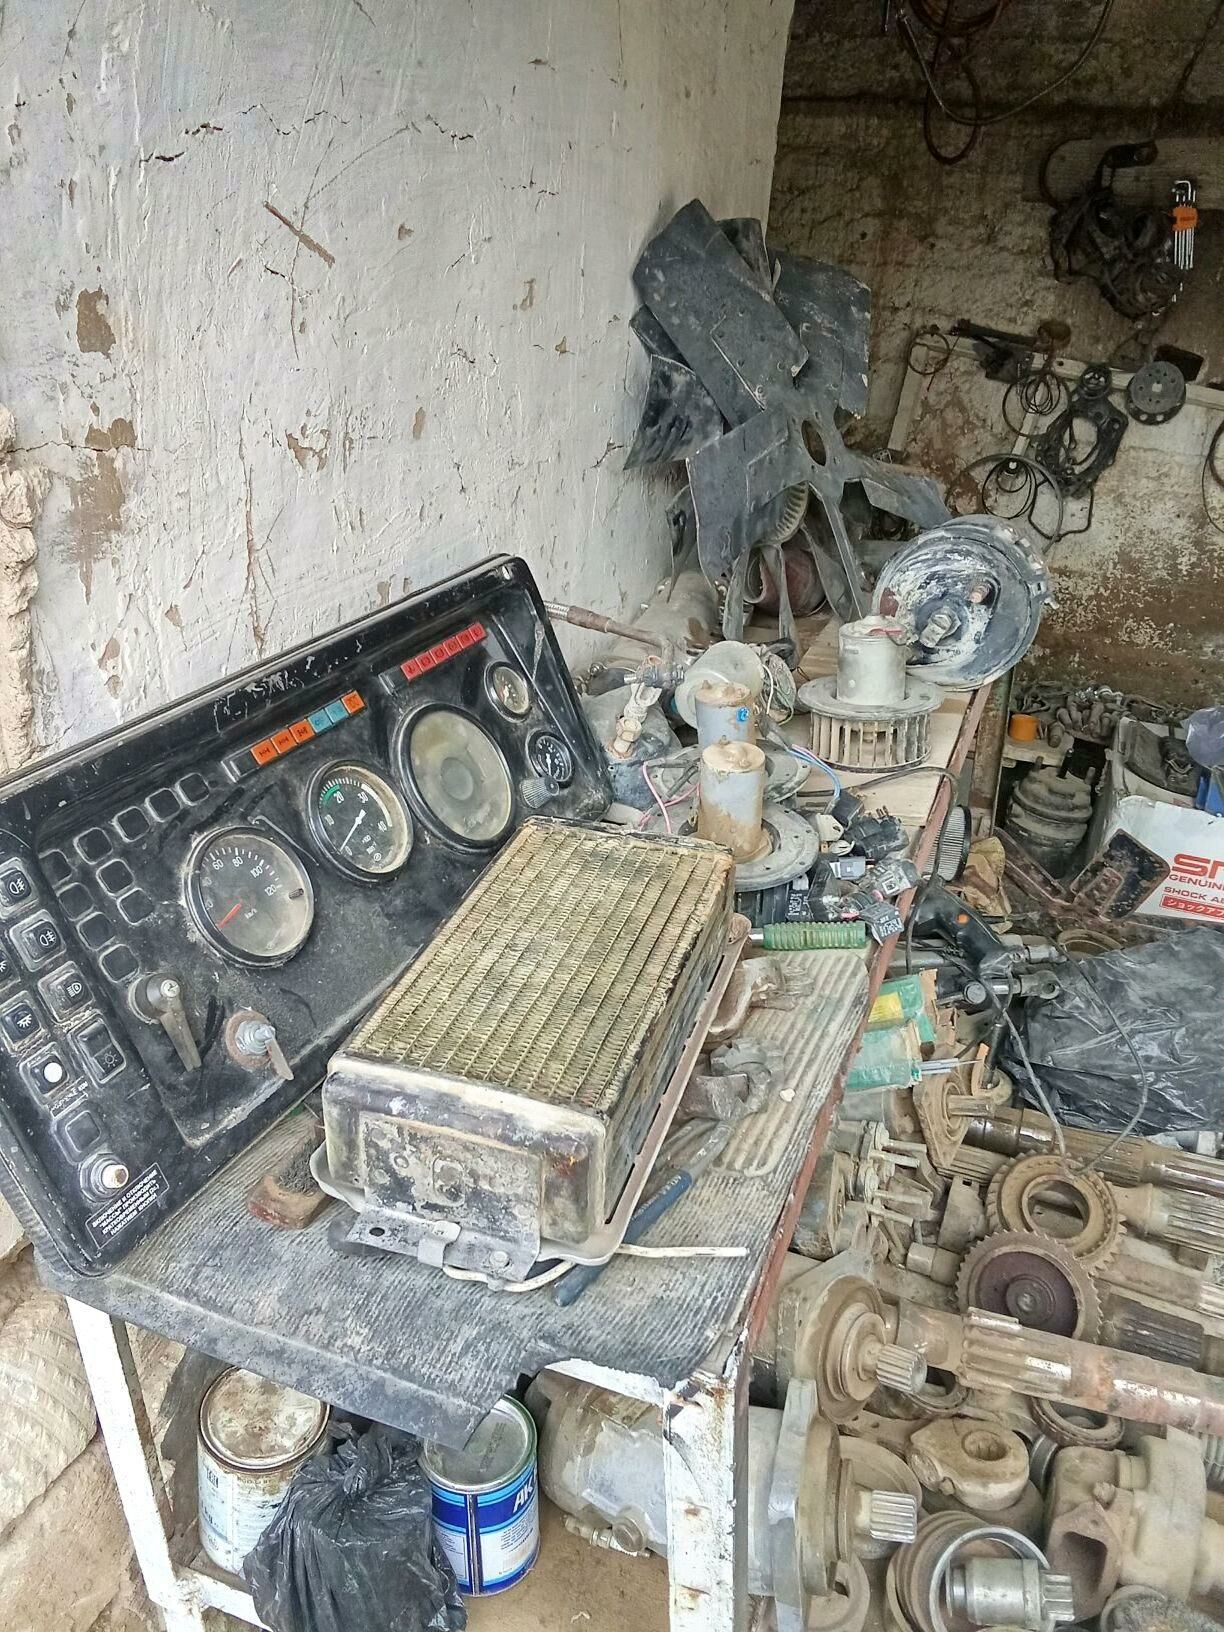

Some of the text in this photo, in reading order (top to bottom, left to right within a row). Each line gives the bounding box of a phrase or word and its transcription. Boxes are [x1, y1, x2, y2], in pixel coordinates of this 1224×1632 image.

[334, 791, 345, 804] 20
[358, 791, 369, 804] 30
[212, 859, 224, 871] 60
[232, 856, 244, 868] 80
[250, 865, 264, 879] 100
[1169, 874, 1224, 890] GENUIN
[264, 884, 277, 897] 120
[1163, 886, 1207, 901] SHOCK
[92, 1199, 123, 1228] ВКЛЮЧЕНИЕ
[126, 1169, 158, 1198] ОТКЛЮЧЕНИЕ
[122, 1179, 157, 1210] ПРОИЗВОДИТЬ
[110, 1209, 138, 1236] НАЖАТИЕМ
